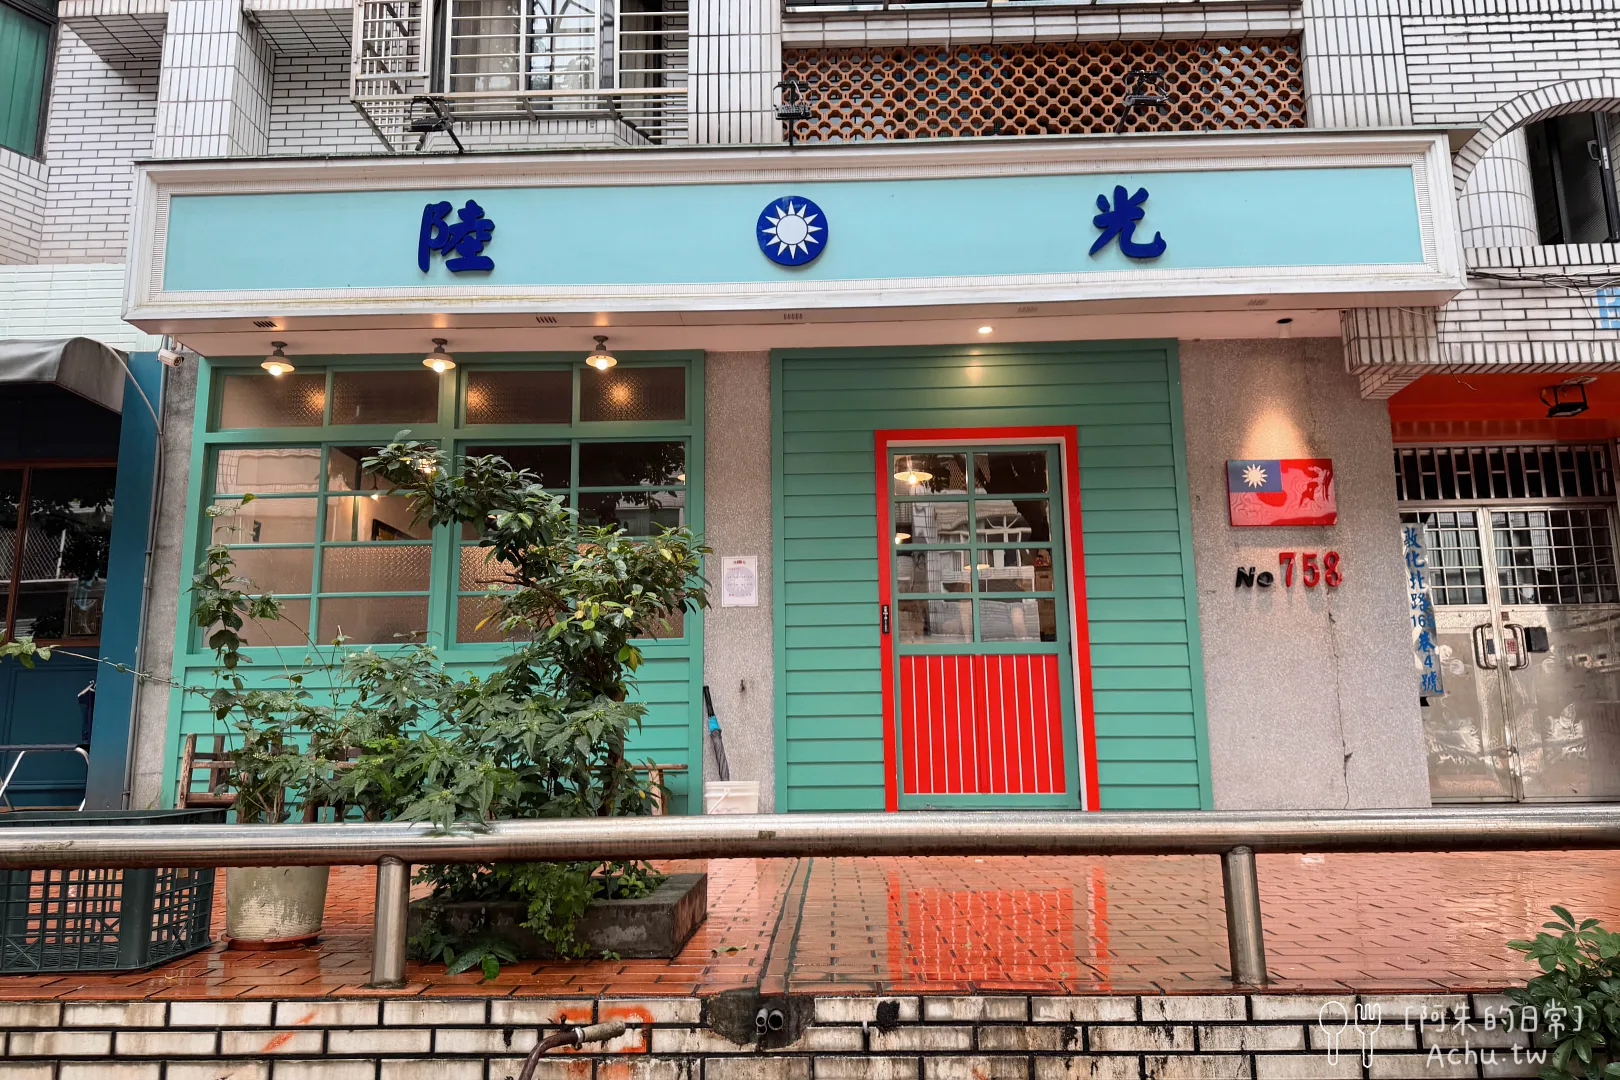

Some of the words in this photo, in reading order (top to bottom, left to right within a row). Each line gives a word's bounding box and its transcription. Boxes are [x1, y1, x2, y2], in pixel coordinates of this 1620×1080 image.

[418, 200, 495, 272] 陸
[1089, 185, 1166, 258] 光
[1236, 566, 1275, 588] No
[1279, 551, 1343, 588] 758
